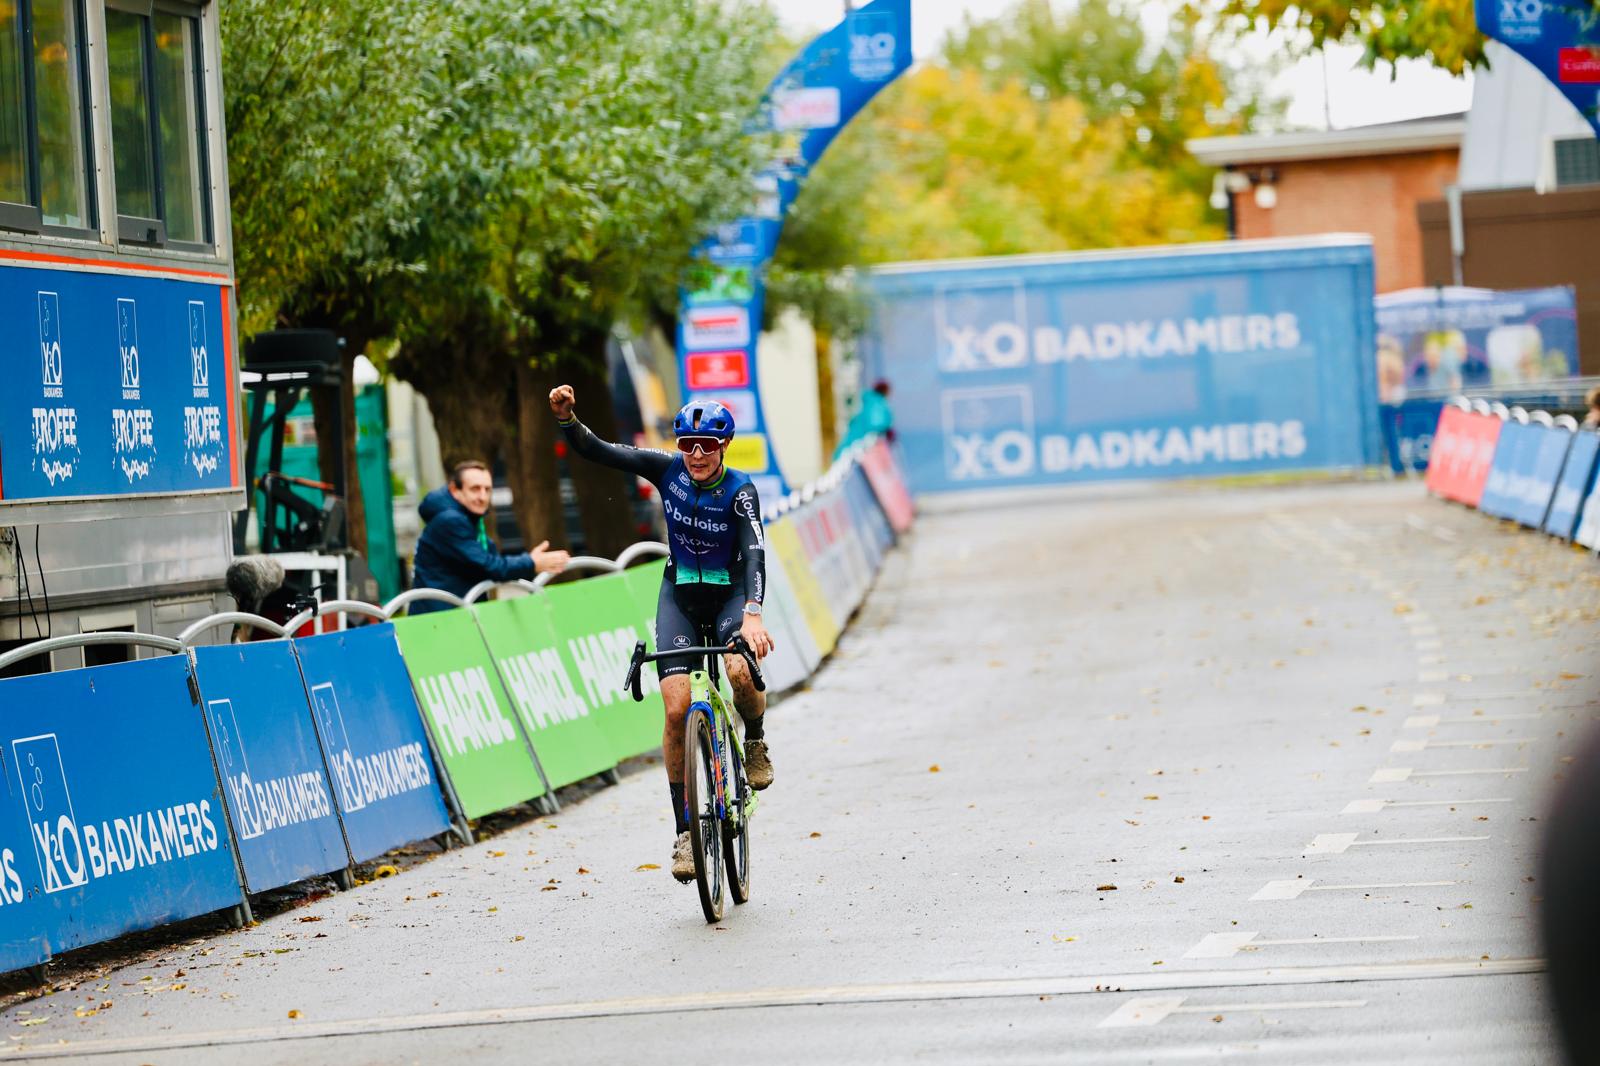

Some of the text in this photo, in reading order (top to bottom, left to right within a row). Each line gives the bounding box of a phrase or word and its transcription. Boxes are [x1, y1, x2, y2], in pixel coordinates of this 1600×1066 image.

[1033, 313, 1299, 364] BADKAMERS
[1041, 421, 1307, 472] BADKAMERS
[673, 507, 728, 533] baloise
[419, 666, 516, 757] HAROL
[501, 647, 589, 732] HAROL
[256, 770, 331, 831] BADKAMERS
[356, 741, 431, 804] BADKAMERS
[83, 800, 218, 878] BADKAMERS
